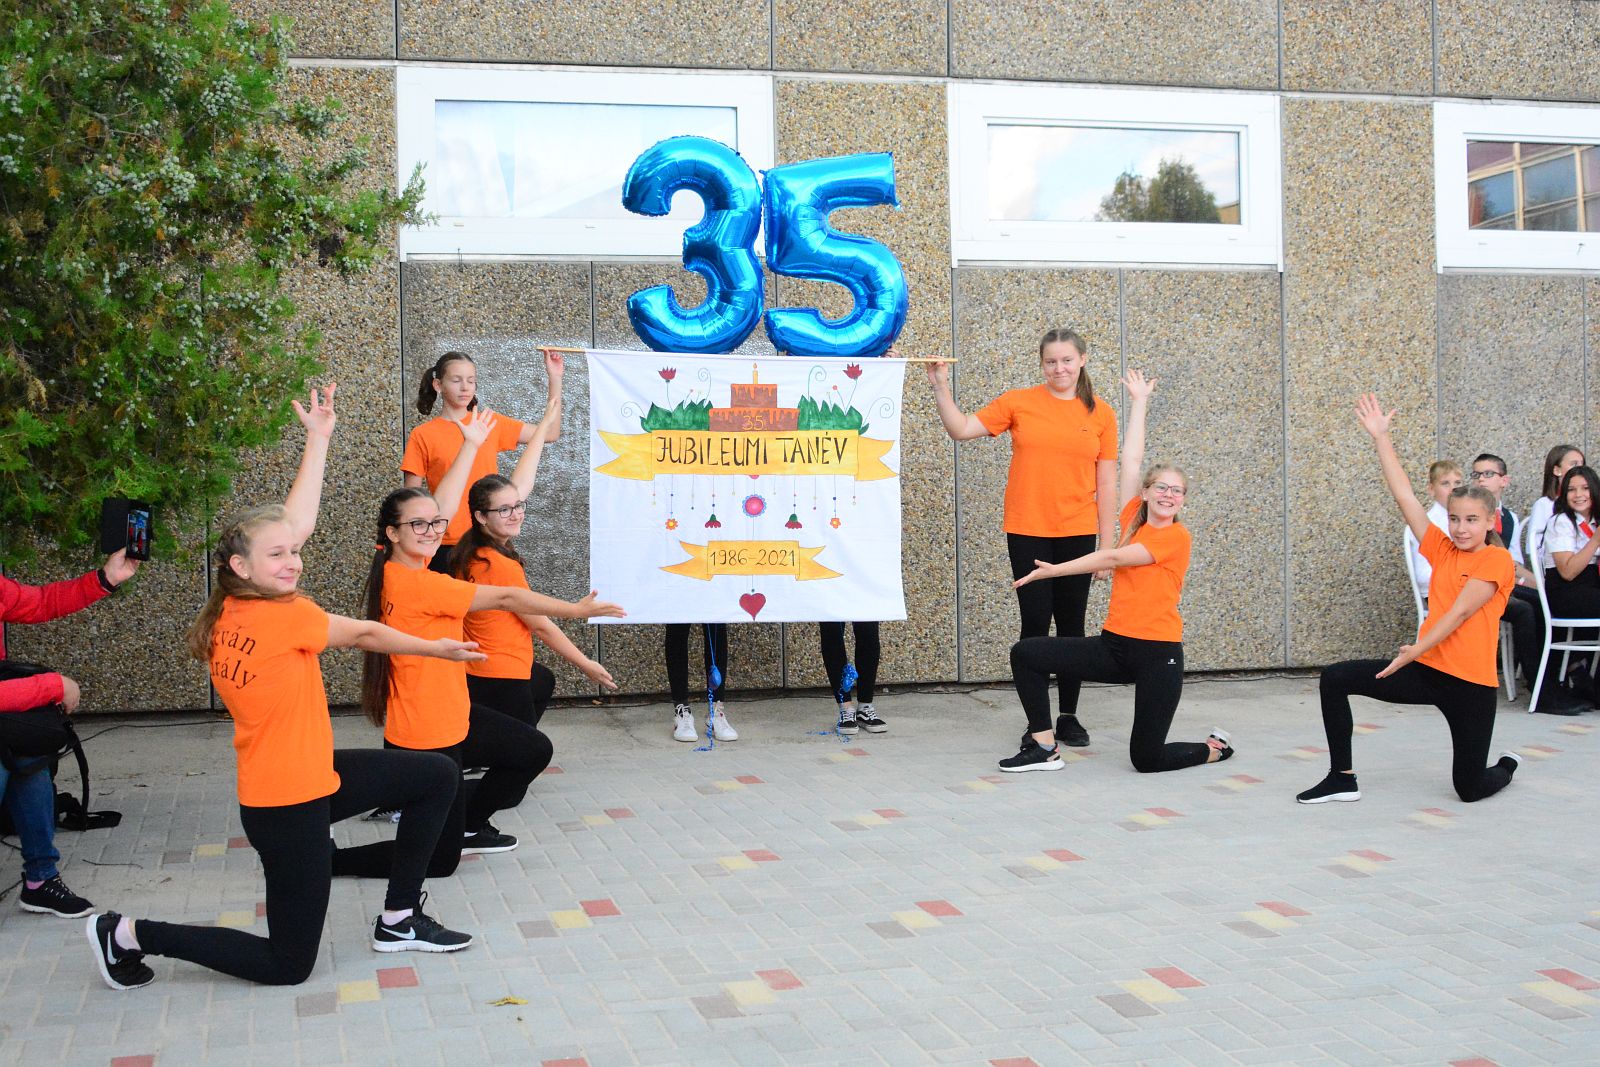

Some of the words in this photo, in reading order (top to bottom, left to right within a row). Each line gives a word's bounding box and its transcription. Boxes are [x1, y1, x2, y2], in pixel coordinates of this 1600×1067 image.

[622, 135, 908, 356] 35
[656, 437, 768, 466] JUBILEUMI
[776, 432, 848, 464] TANÉV
[710, 548, 795, 566] 1986-2021
